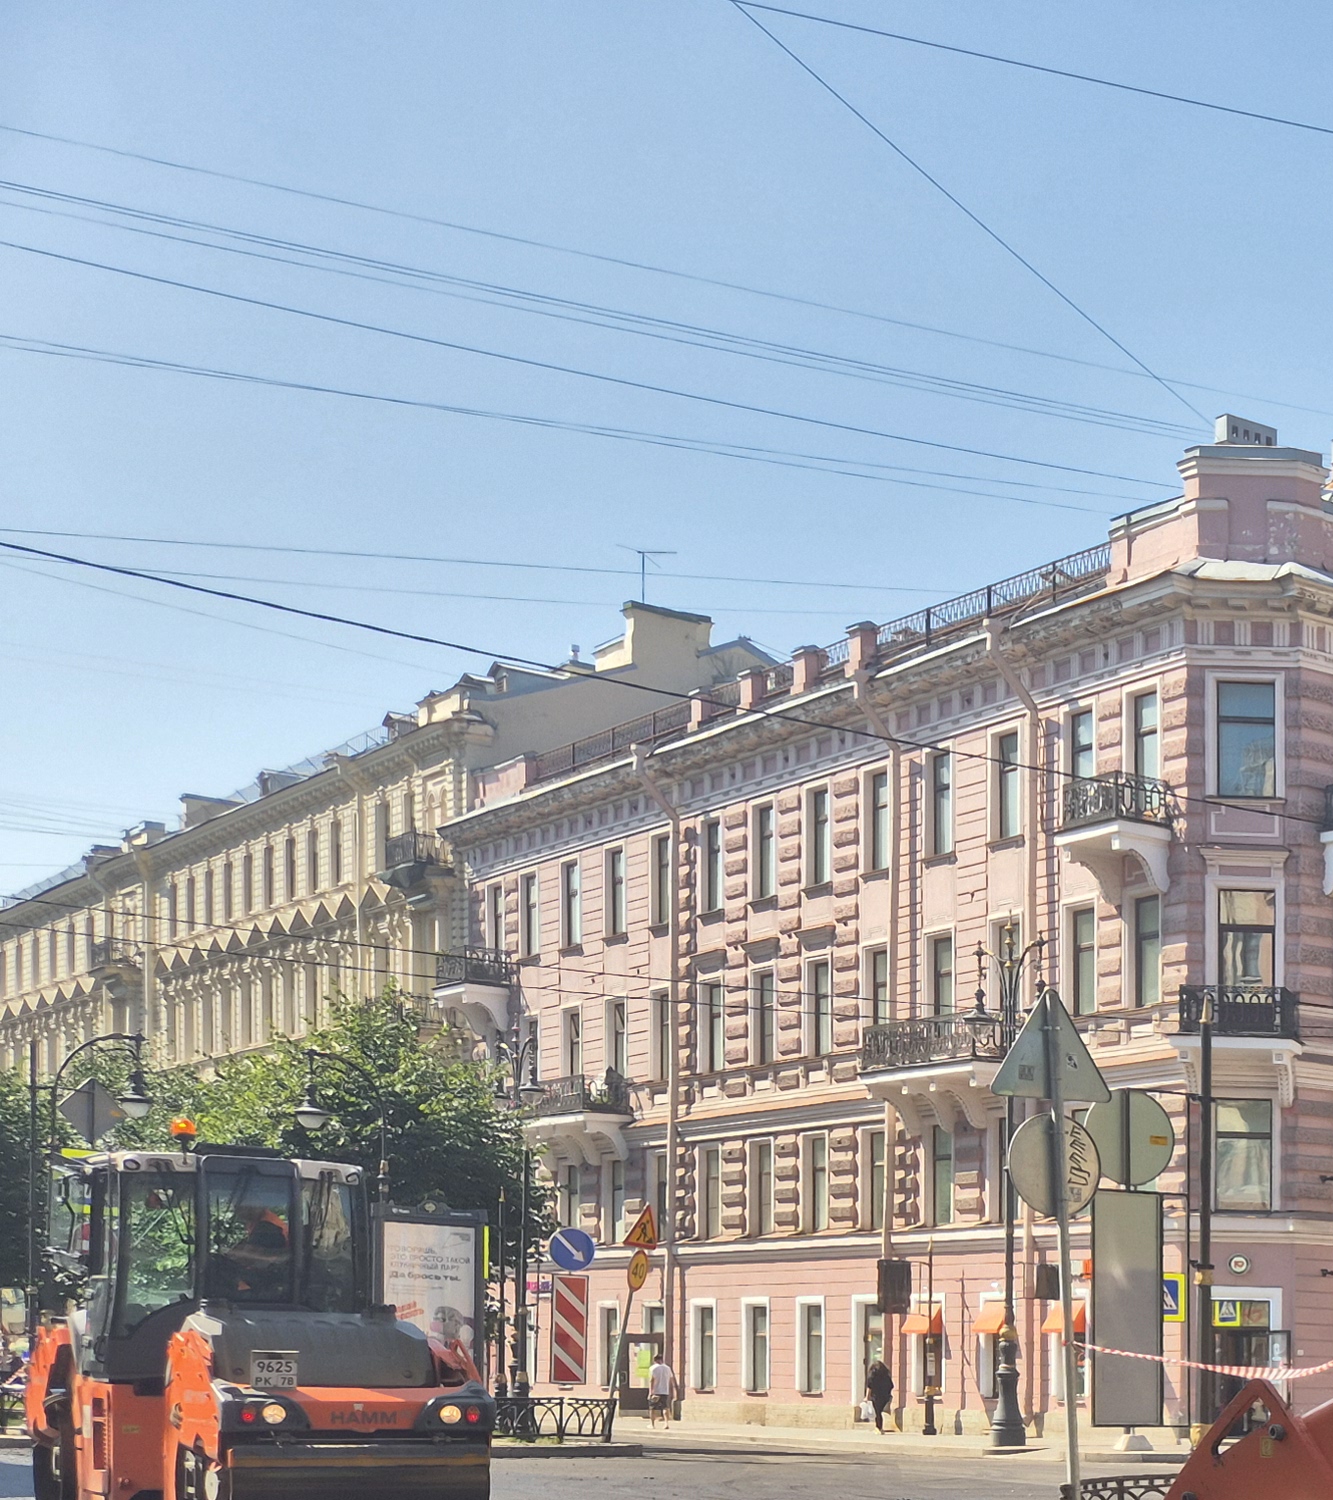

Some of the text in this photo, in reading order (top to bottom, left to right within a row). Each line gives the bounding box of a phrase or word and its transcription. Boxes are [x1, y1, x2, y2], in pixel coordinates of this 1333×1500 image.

[390, 1271, 406, 1279] Да
[408, 1271, 441, 1280] брось
[632, 1264, 644, 1280] 40
[257, 1361, 293, 1373] 9625
[281, 1377, 294, 1386] 78
[330, 1411, 397, 1425] HAMM
